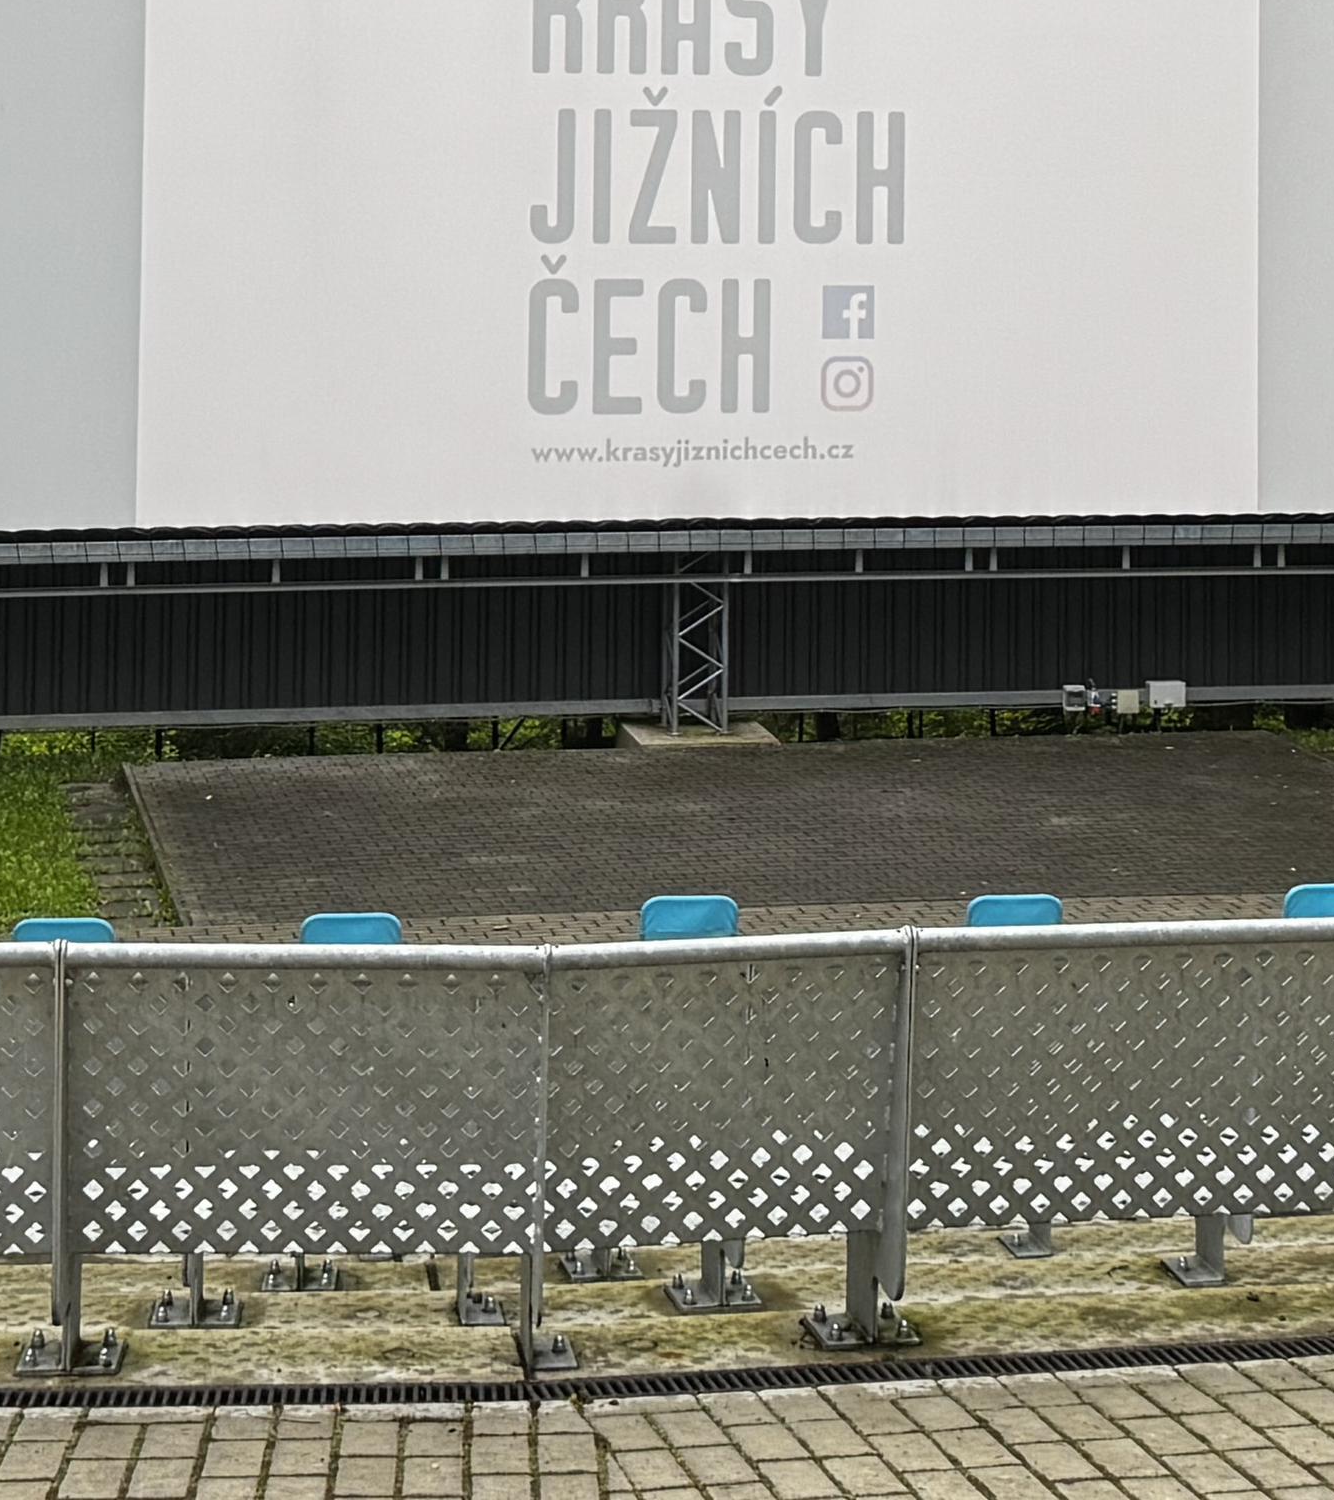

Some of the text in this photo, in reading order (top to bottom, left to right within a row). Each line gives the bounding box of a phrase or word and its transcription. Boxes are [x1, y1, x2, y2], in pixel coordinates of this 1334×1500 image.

[529, 84, 906, 246] JIŽNÍCH
[526, 253, 772, 417] ČECH
[530, 435, 855, 469] www.krasyjiznichcech.cz
